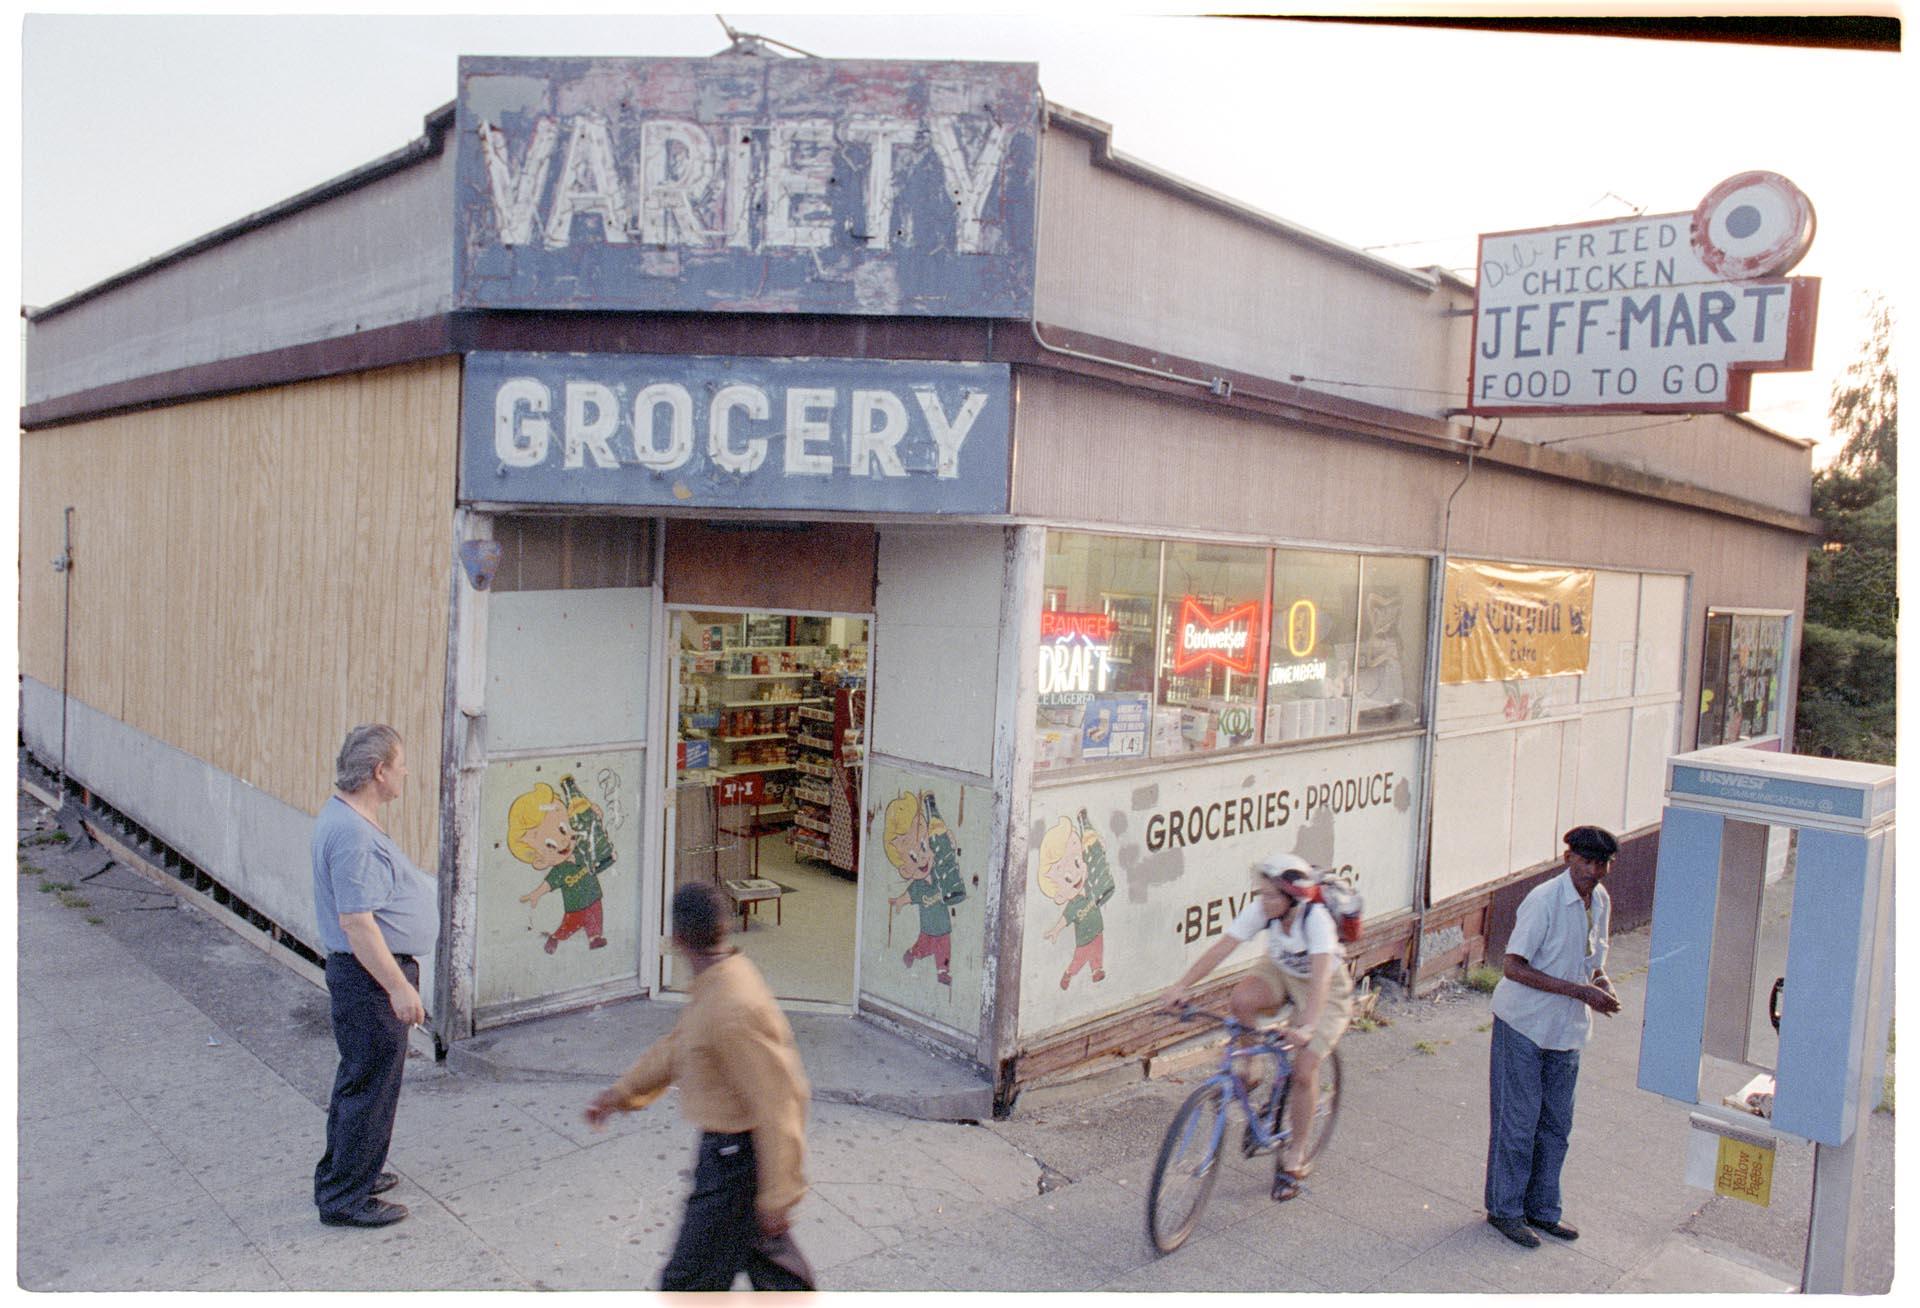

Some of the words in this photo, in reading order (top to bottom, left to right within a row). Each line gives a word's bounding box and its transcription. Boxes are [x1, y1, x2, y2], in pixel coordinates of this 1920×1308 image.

[478, 113, 1008, 254] VARIETY
[1554, 224, 1676, 260] FRIED
[1483, 239, 1543, 288] Deli
[1522, 257, 1676, 296] CHICKEN
[1481, 286, 1786, 360] JEFF-MART
[1481, 370, 1571, 400] FOOD
[1592, 367, 1637, 397] TO
[1663, 363, 1719, 394] GO
[494, 376, 989, 480] GROCERY
[1042, 613, 1110, 638] RAINIER
[1184, 623, 1248, 650] Budweiser
[1038, 643, 1109, 694] DRAFT
[1218, 707, 1254, 736] KOOL
[1146, 789, 1290, 853] GROCERIES
[1305, 771, 1395, 821] PRODUCE
[1718, 1164, 1733, 1189] The
[1732, 1151, 1750, 1193] Yellow
[1745, 1161, 1764, 1198] Pages
